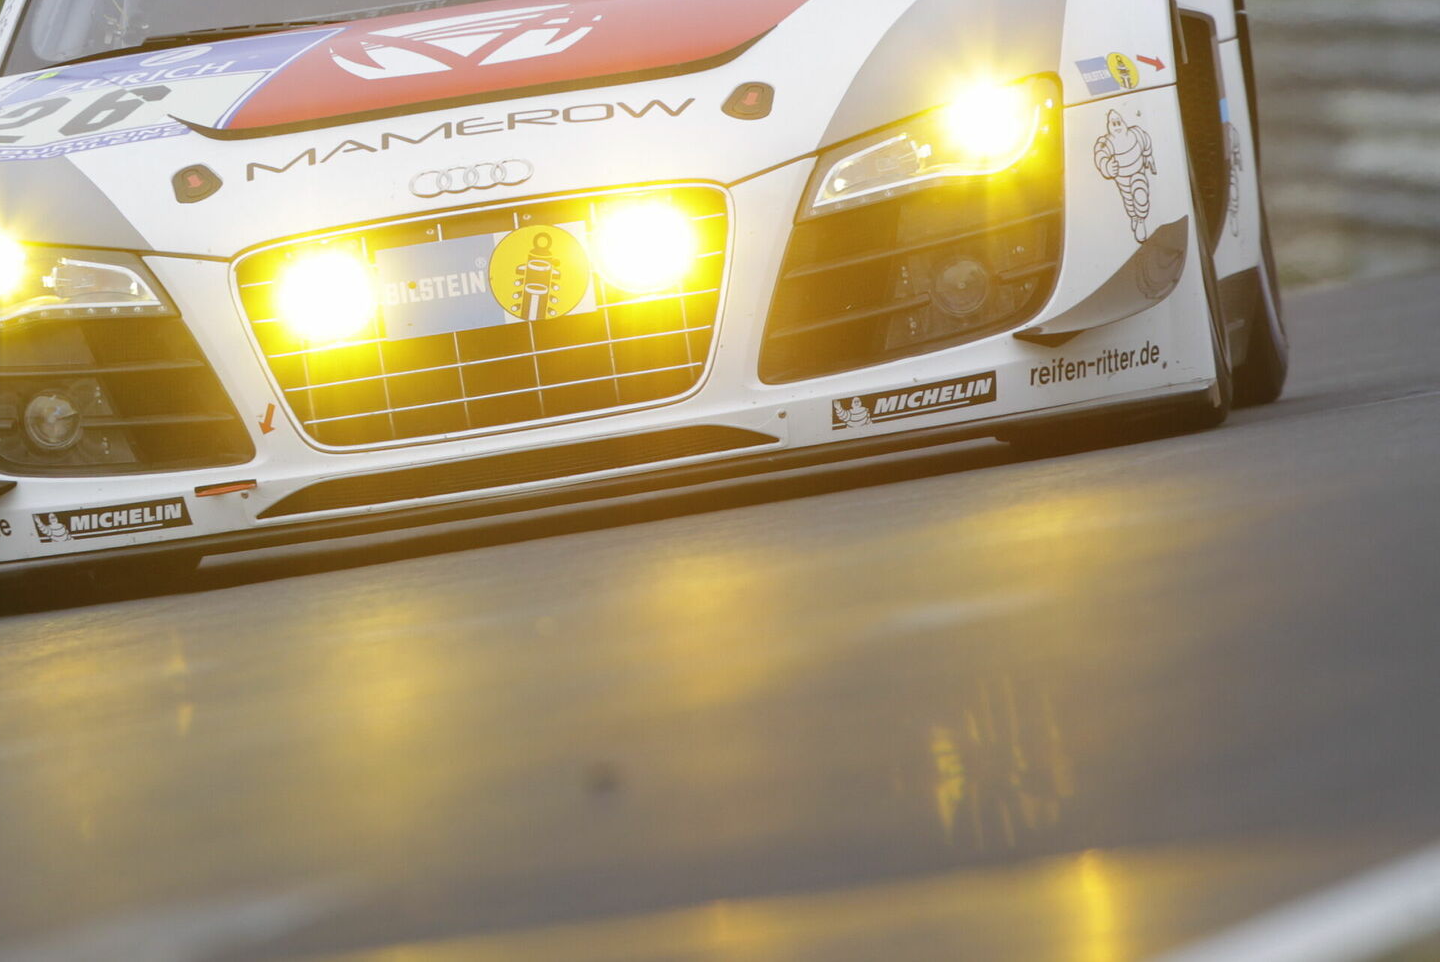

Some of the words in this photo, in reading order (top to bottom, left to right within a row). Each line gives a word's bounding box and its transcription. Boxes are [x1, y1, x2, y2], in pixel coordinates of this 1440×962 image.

[245, 97, 696, 182] MAMEROW
[382, 269, 487, 306] BILSTEIN
[1030, 340, 1160, 386] reifen-ritter.de
[874, 377, 992, 415] MICHELIN
[70, 502, 183, 532] MICHELIN
